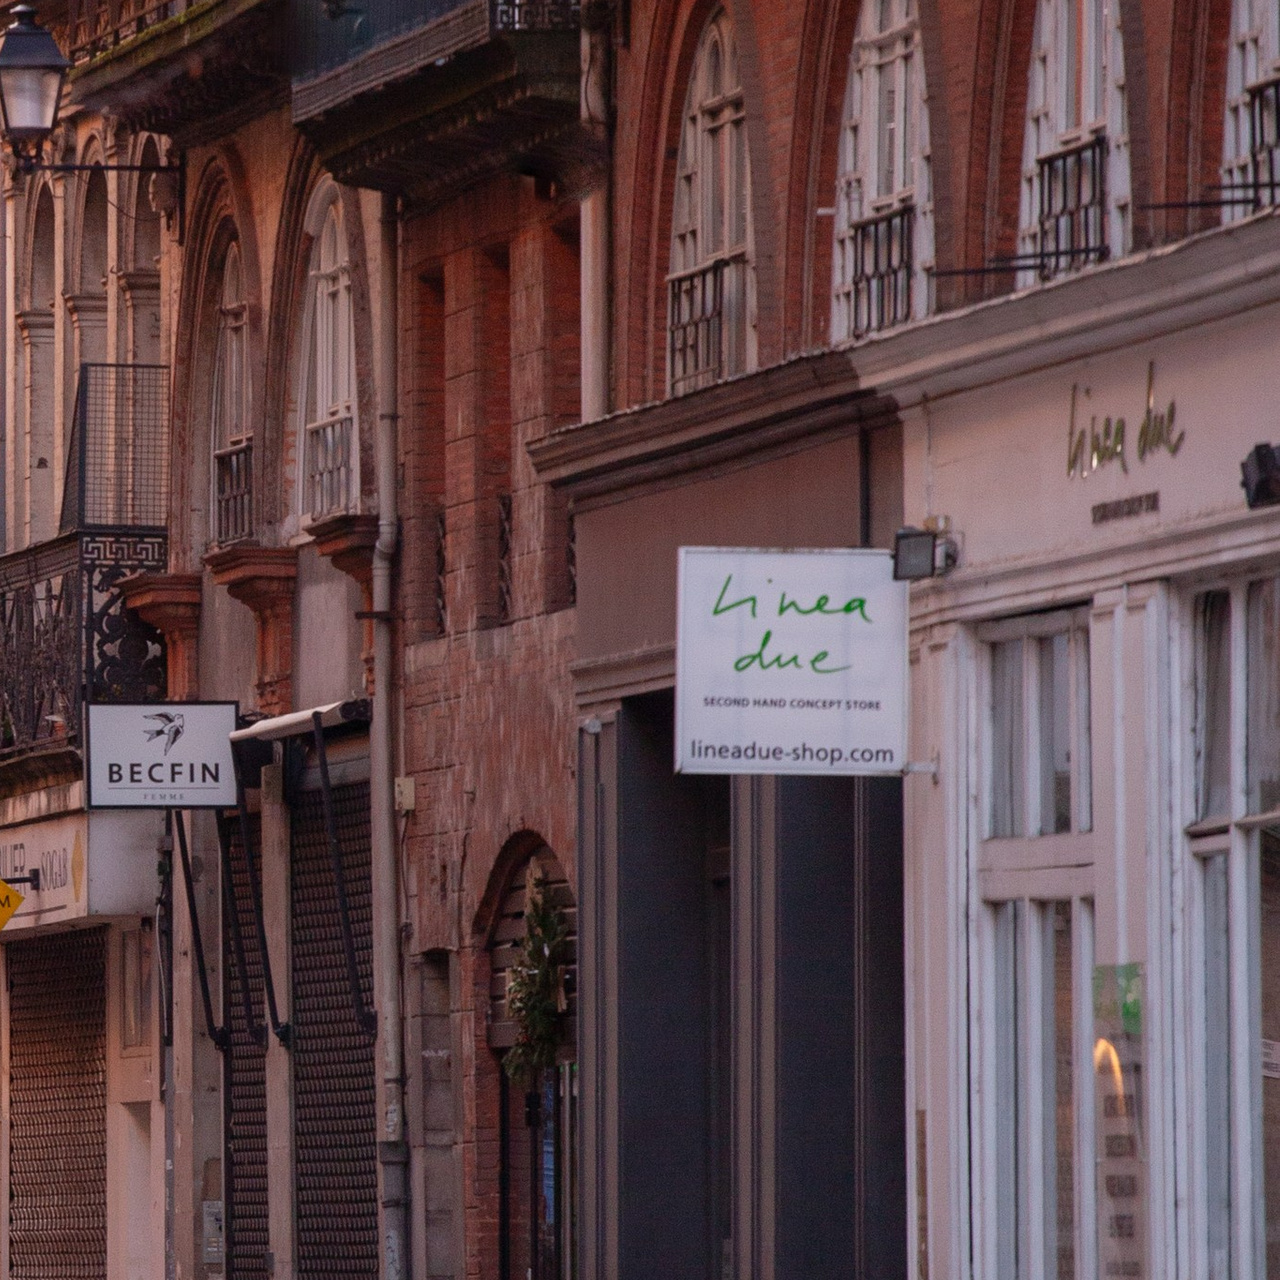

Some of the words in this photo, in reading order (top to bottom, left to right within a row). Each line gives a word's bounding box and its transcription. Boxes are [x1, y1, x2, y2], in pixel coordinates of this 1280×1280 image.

[733, 630, 853, 673] due
[703, 697, 750, 708] SECOND
[753, 698, 786, 708] HAND
[790, 699, 841, 709] CONCEPT
[846, 700, 881, 710] STORE
[690, 740, 894, 766] lineadue-shop.com
[108, 763, 220, 783] BECFIN
